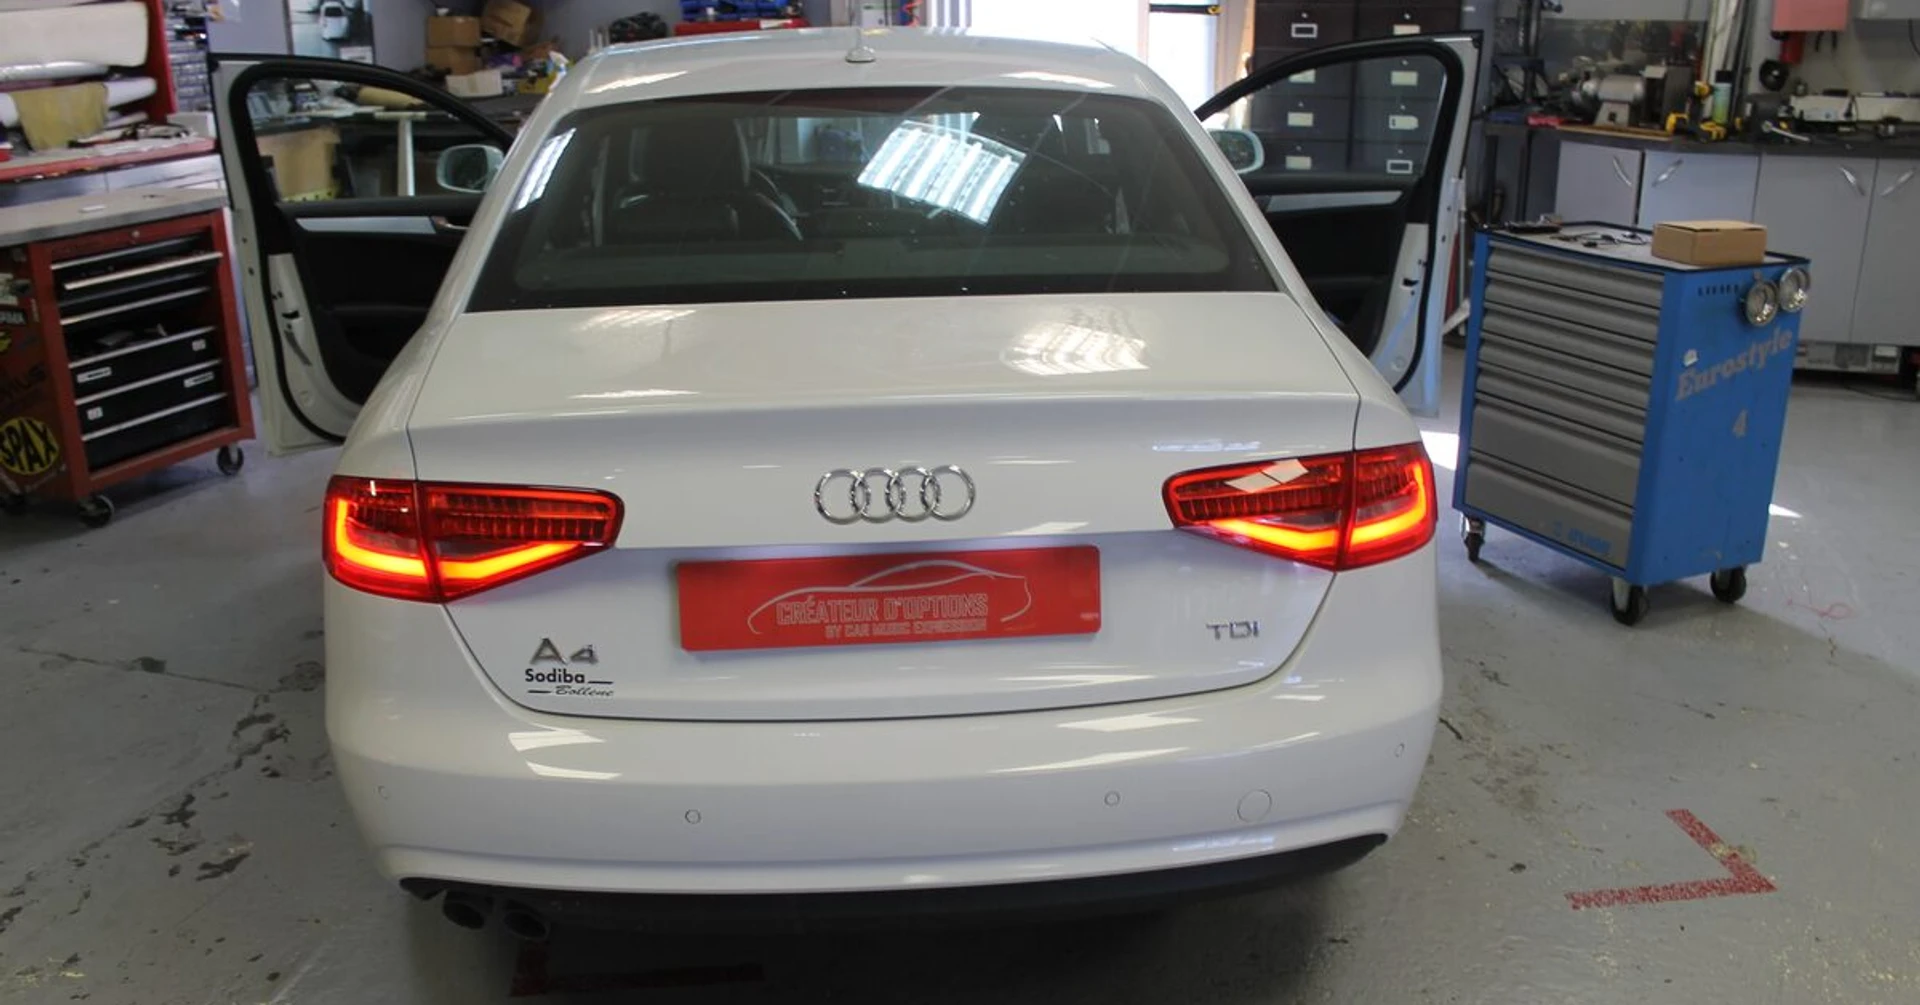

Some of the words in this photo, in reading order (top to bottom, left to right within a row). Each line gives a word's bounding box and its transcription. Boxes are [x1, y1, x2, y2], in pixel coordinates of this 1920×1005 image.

[1675, 326, 1792, 402] Eurostyle
[1732, 409, 1748, 438] 4
[776, 594, 879, 625] CRÉATEUR
[883, 593, 989, 620] D'OPTIONS
[825, 624, 842, 639] BY
[845, 623, 870, 637] CAR
[1206, 620, 1259, 640] TDI
[530, 637, 599, 665] A4
[525, 668, 585, 683] Sodiba
